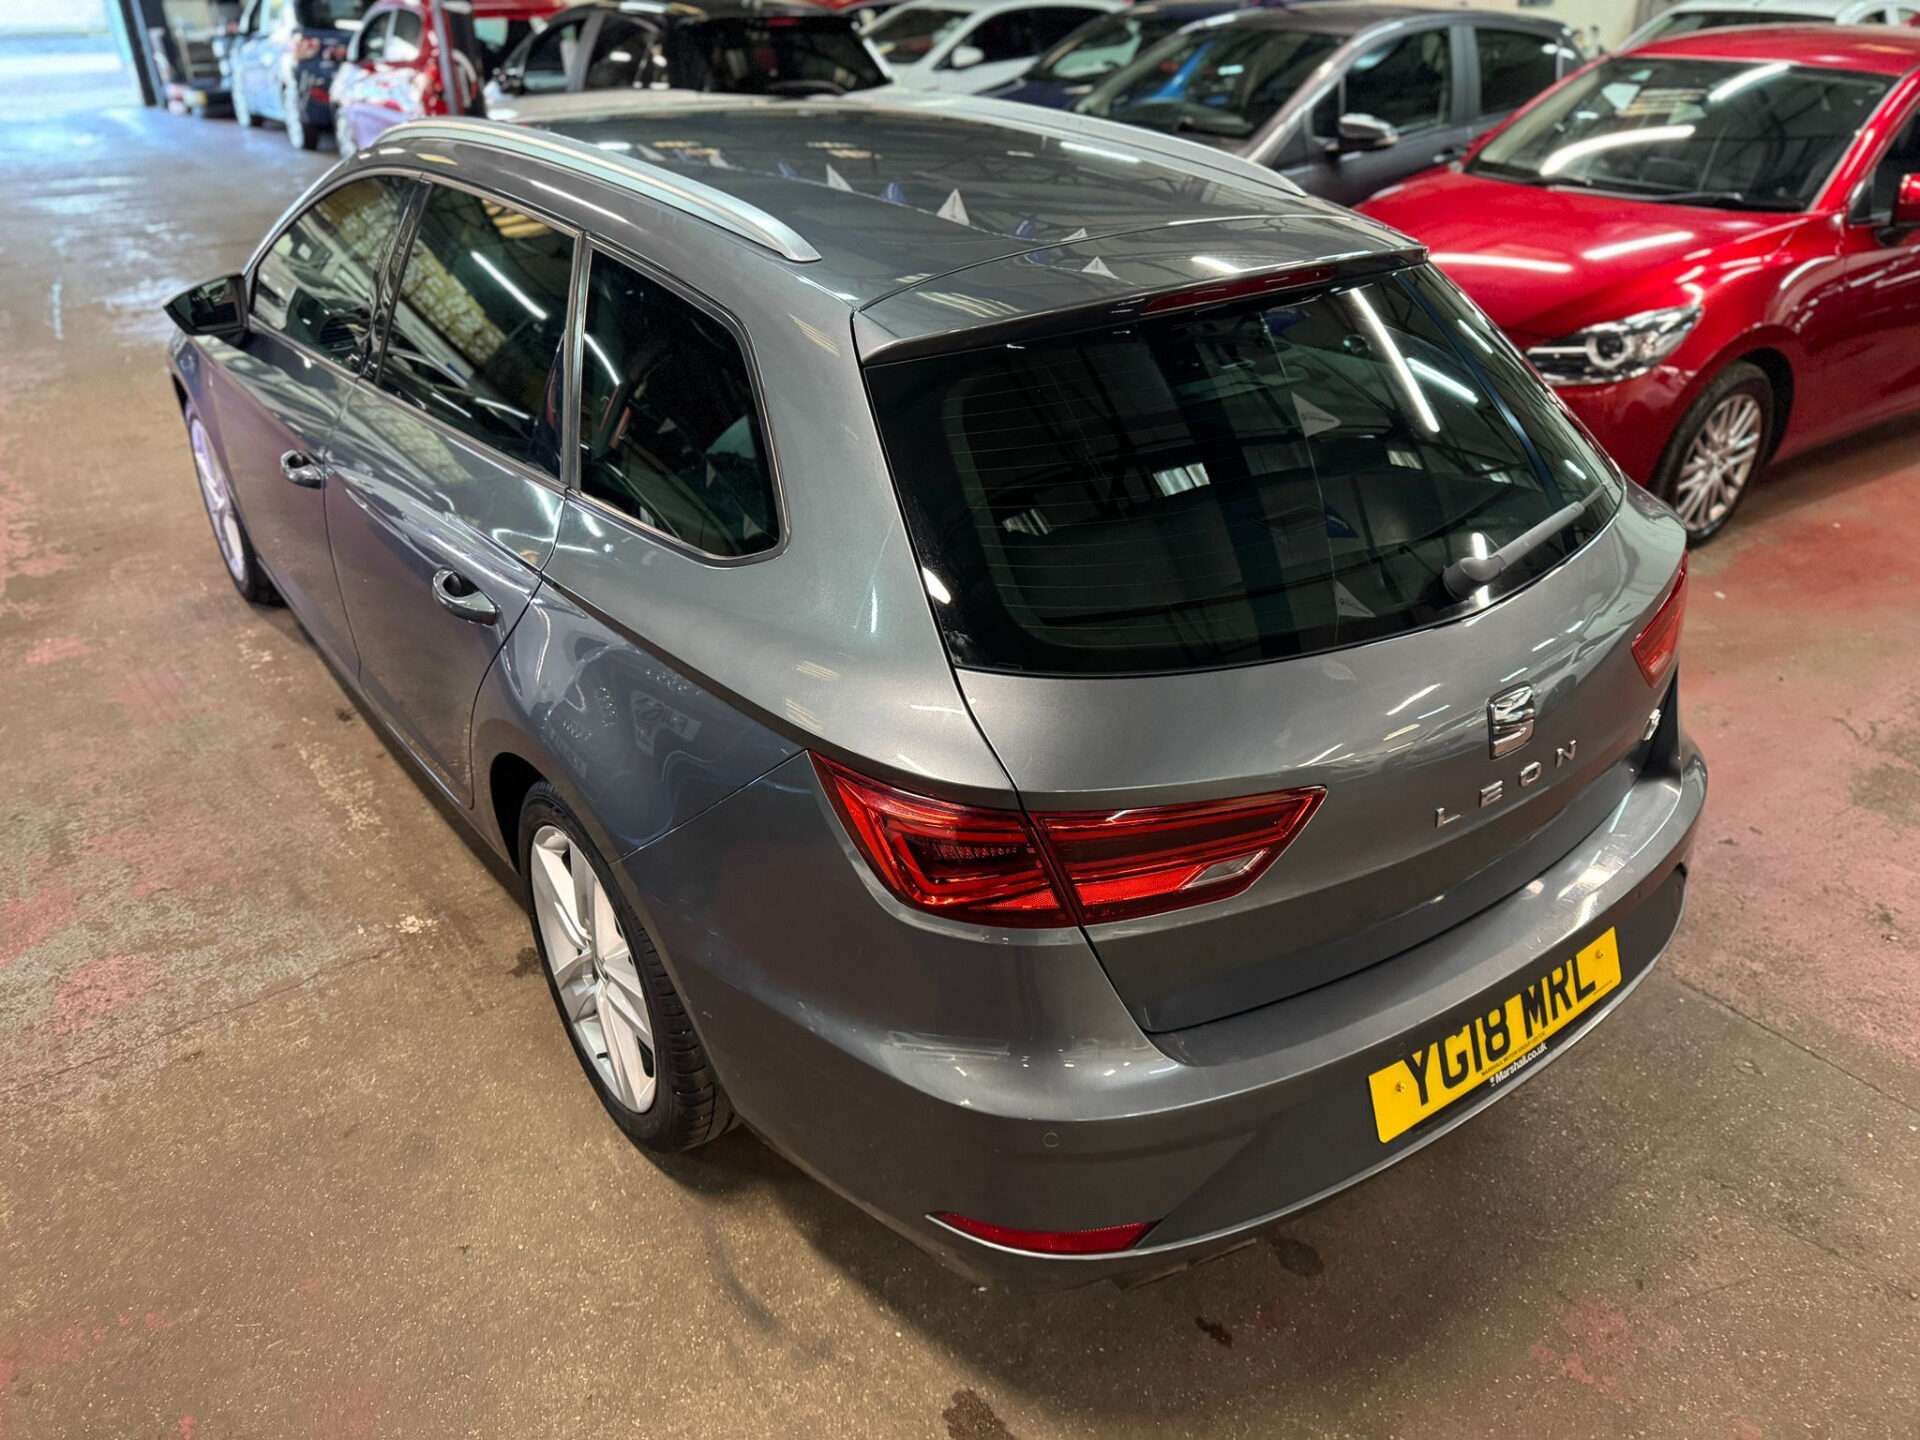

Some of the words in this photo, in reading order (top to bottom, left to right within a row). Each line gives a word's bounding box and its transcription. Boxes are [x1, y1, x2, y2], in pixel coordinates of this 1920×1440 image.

[1434, 739, 1577, 828] LEON
[1401, 1006, 1511, 1106] YG18
[1520, 956, 1596, 1040] MRL
